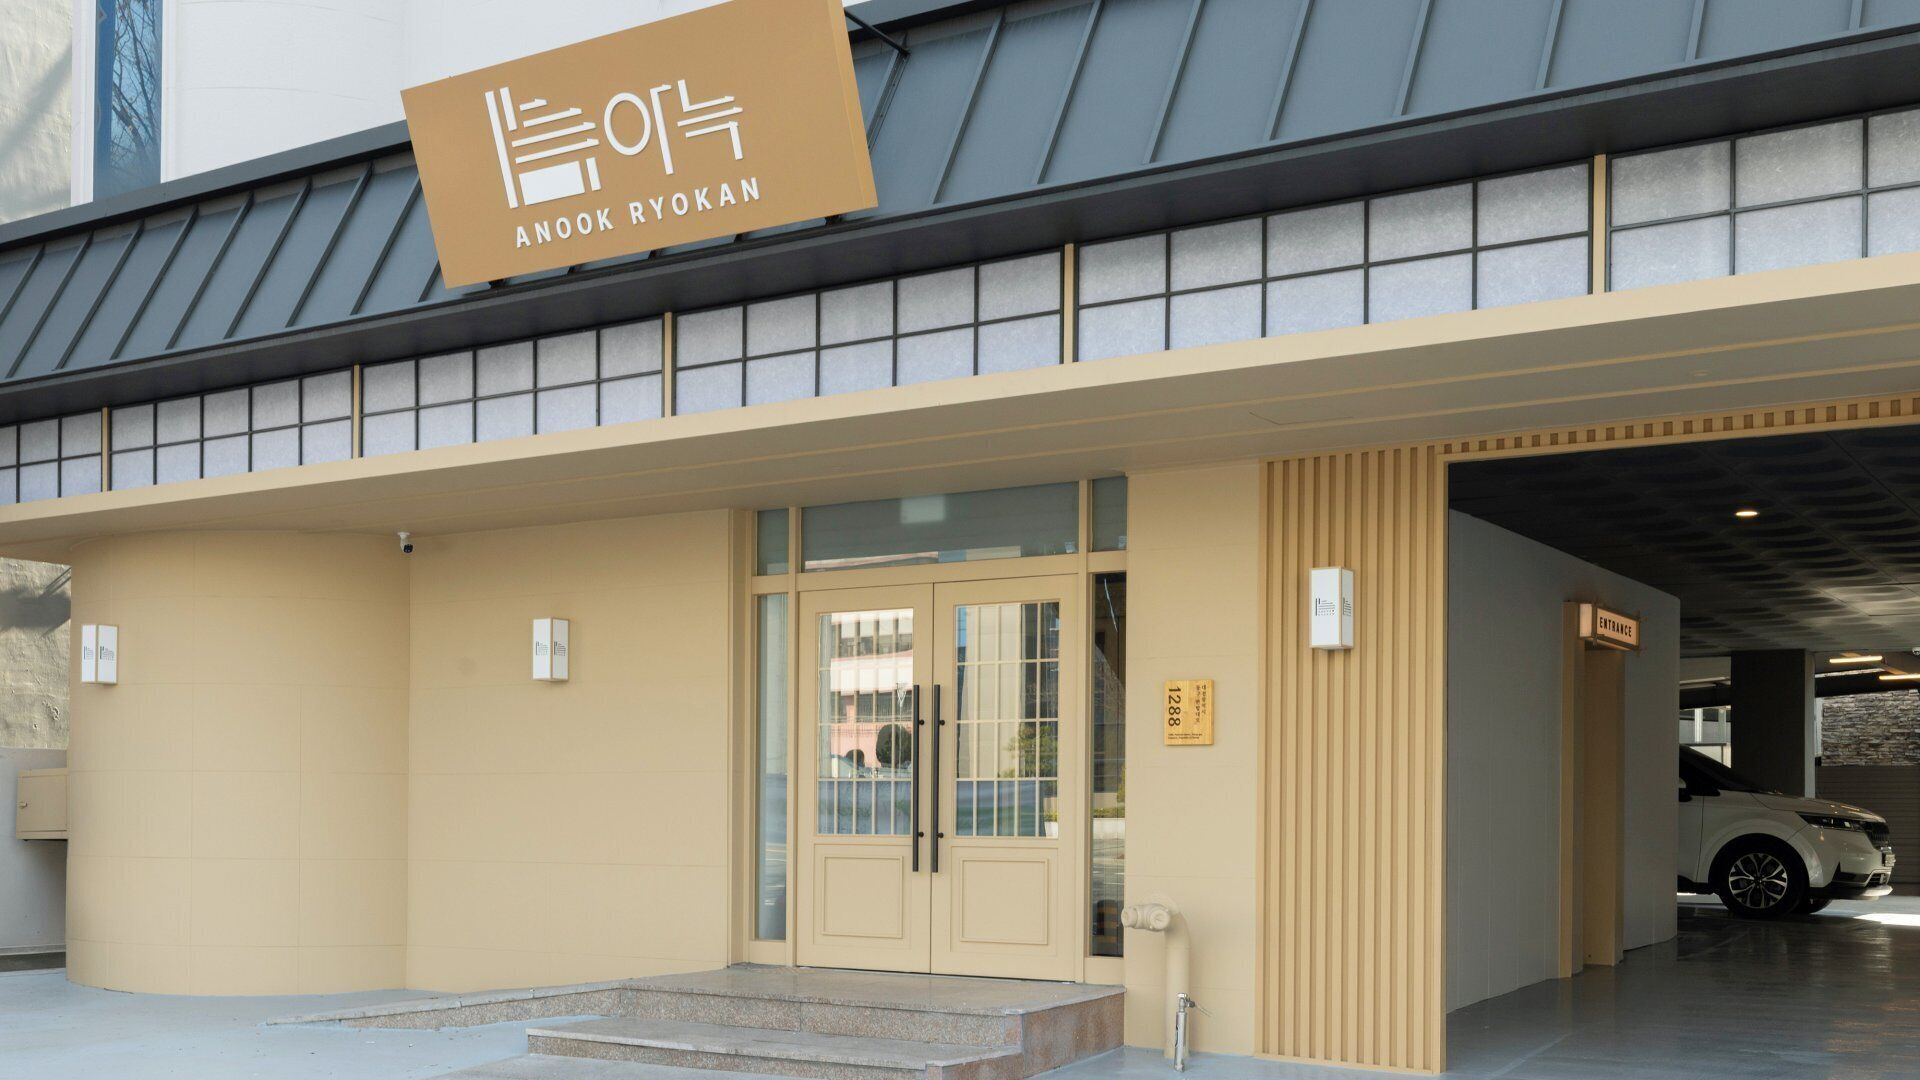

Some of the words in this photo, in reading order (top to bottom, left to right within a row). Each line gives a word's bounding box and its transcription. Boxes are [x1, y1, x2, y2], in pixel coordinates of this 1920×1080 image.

[516, 208, 616, 249] ANOOK
[629, 176, 761, 226] RYOKAN
[1599, 617, 1632, 637] ENTRANCE
[1168, 686, 1181, 726] 1288
